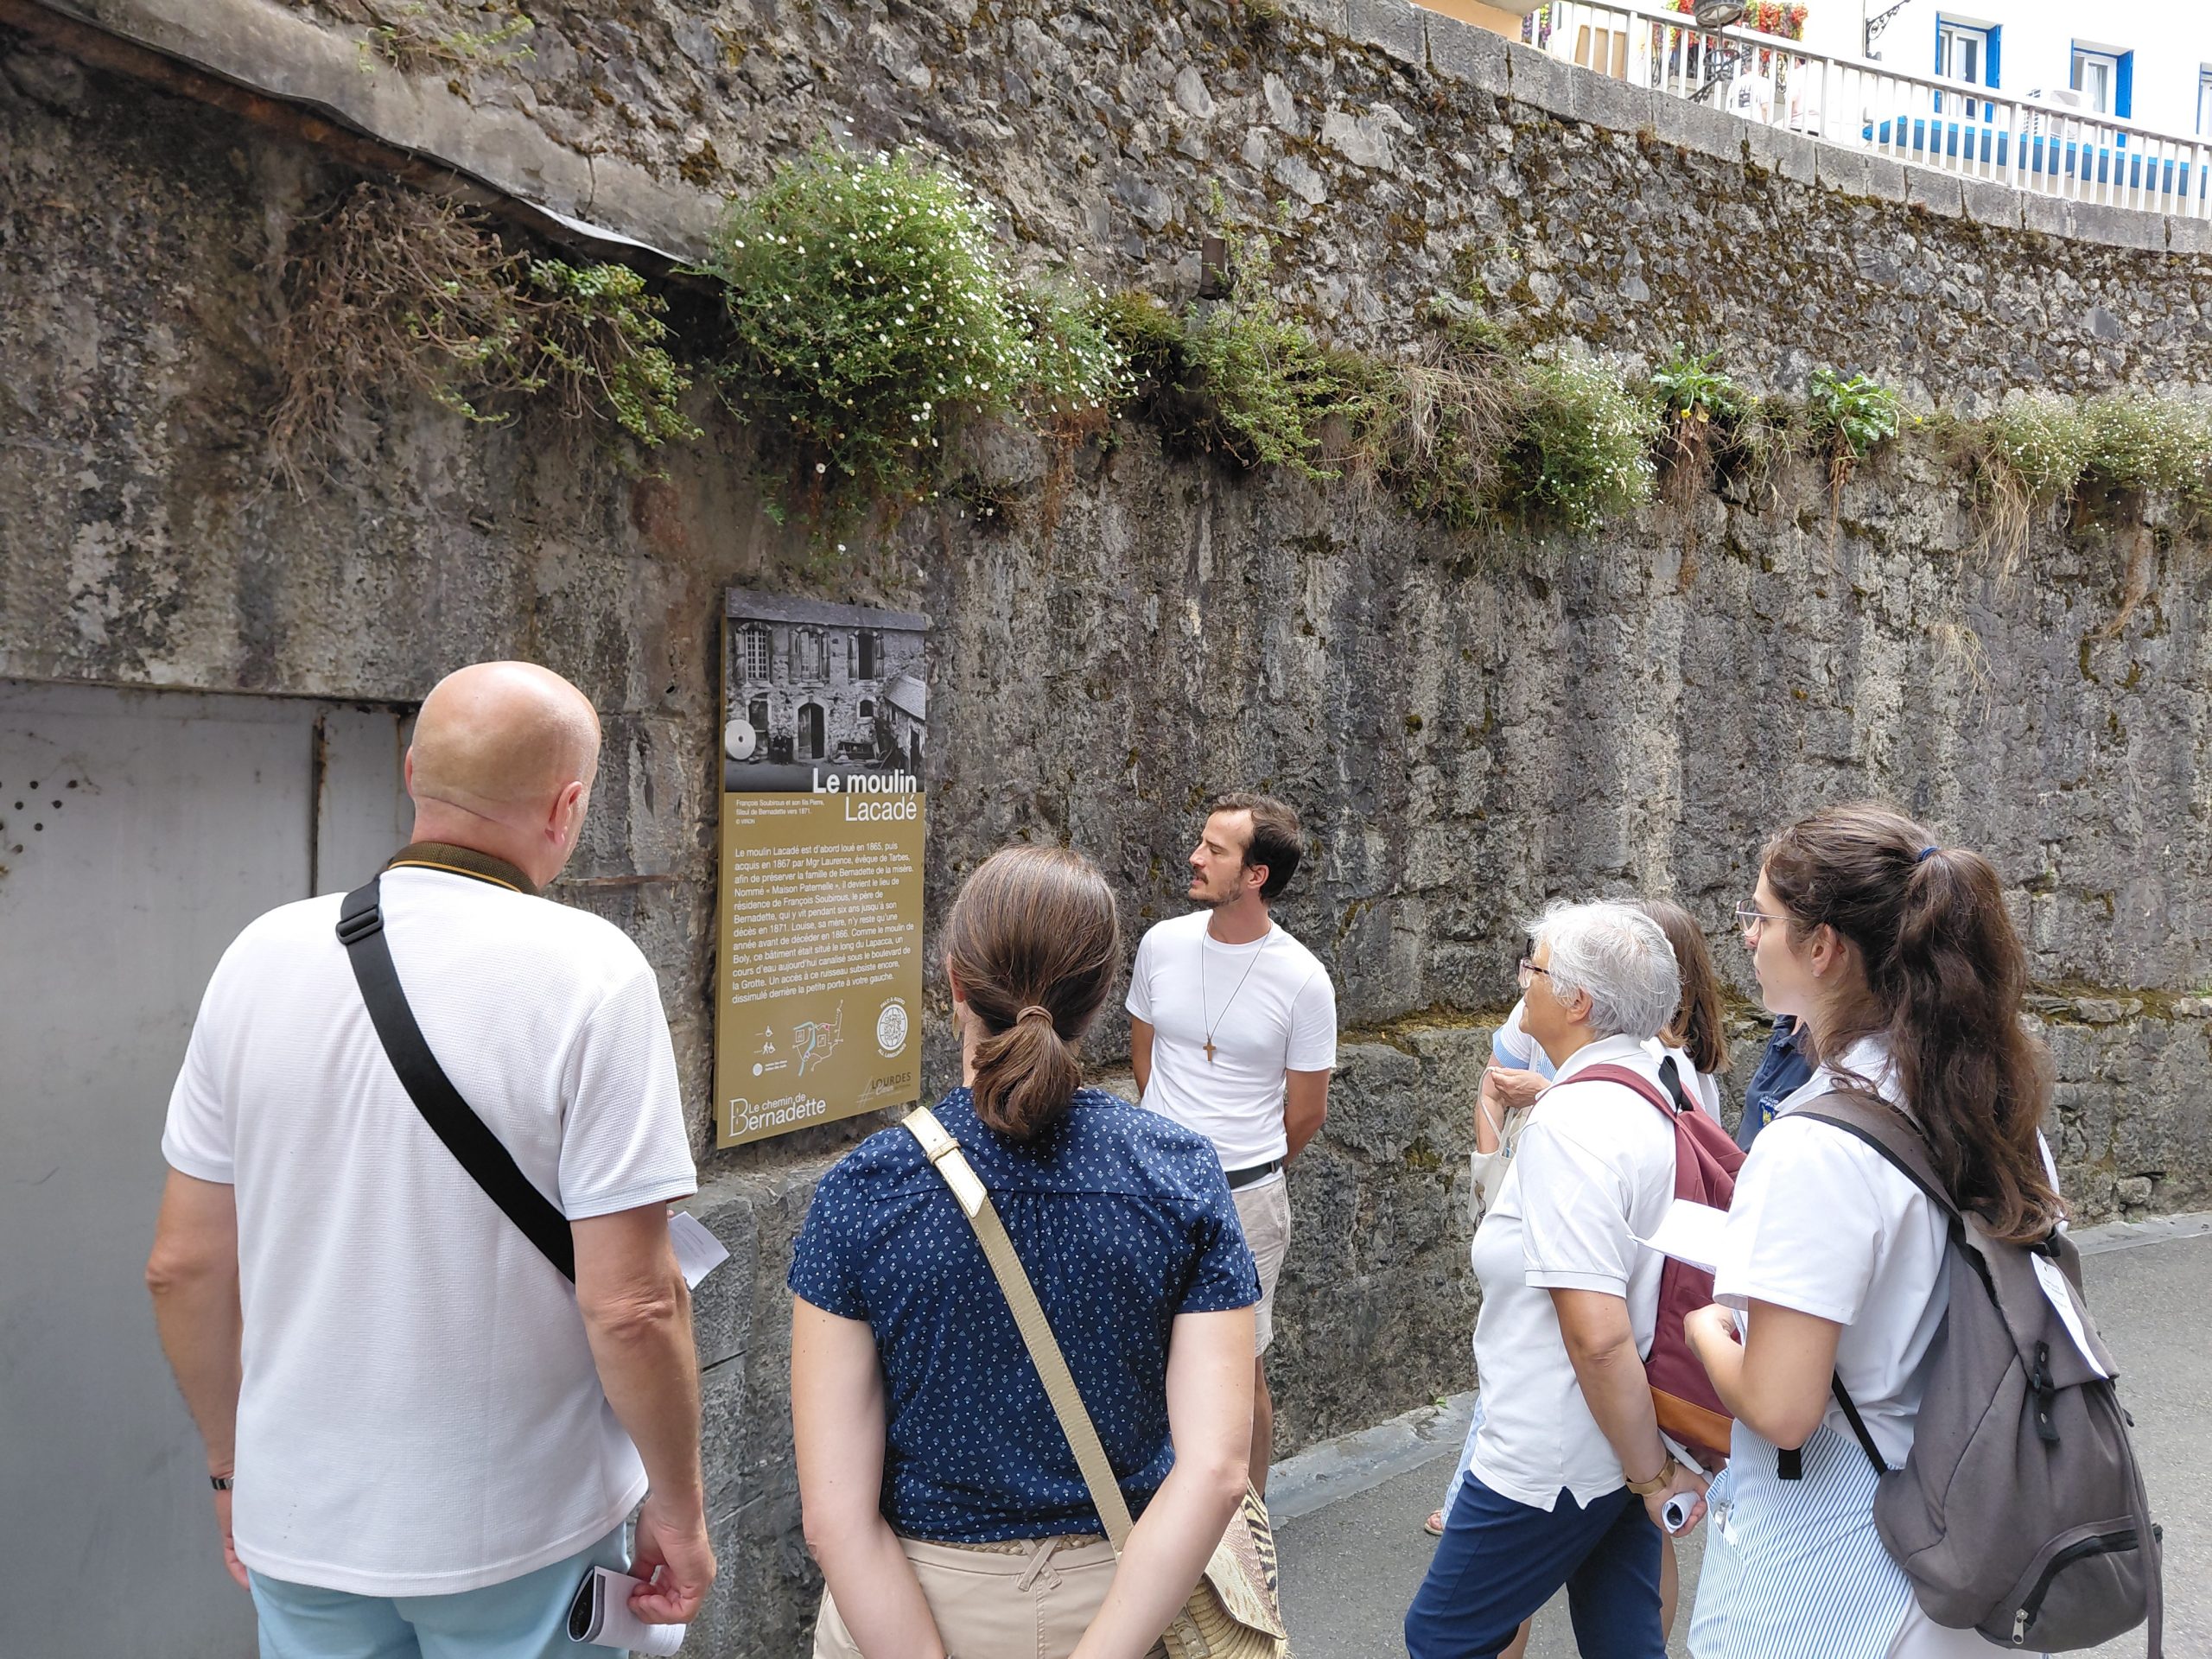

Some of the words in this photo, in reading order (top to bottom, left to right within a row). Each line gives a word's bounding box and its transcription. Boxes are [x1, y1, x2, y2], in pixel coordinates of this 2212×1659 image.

[813, 767, 840, 793] Le
[848, 768, 917, 793] moulin
[845, 794, 917, 821] Lacadé
[735, 848, 745, 857] Le
[747, 846, 772, 856] moulin
[773, 844, 799, 855] Lacadé
[801, 845, 812, 854] est
[841, 842, 855, 852] loué
[885, 842, 899, 851] puis
[734, 861, 760, 872] acquis
[773, 859, 791, 868] 1867
[792, 860, 804, 868] par
[805, 857, 819, 868] Mgr
[734, 874, 748, 884] afin
[751, 874, 760, 883] de
[762, 872, 797, 883] préserver
[798, 871, 804, 880] la
[805, 870, 828, 879] famille
[839, 868, 874, 877] Bernadette
[734, 886, 765, 897] Nommé
[772, 885, 798, 894] Maison
[799, 881, 834, 892] Paternelle
[848, 879, 871, 888] devient
[872, 878, 878, 887] le
[879, 877, 891, 886] lieu
[734, 899, 771, 911] résidence
[772, 899, 782, 907] de
[783, 896, 813, 906] François
[852, 892, 858, 900] le
[859, 891, 874, 901] père
[779, 910, 791, 920] qui
[791, 911, 797, 919] y
[798, 908, 806, 917] vit
[808, 906, 836, 918] pendant
[837, 905, 847, 914] six
[733, 939, 756, 950] année
[758, 938, 779, 948] avant
[791, 933, 820, 944] décéder
[851, 928, 876, 937] Comme
[885, 924, 905, 932] moulin
[734, 926, 757, 937] décès
[791, 920, 817, 931] Louise,
[859, 915, 875, 924] reste
[733, 954, 752, 963] Boly,
[765, 949, 796, 959] bâtiment
[798, 946, 813, 955] était
[814, 944, 830, 953] situé
[840, 942, 854, 950] long
[733, 968, 754, 977] cours
[818, 954, 846, 965] canalisé
[872, 948, 901, 958] boulevard
[733, 982, 739, 990] la
[769, 976, 779, 985] Un
[781, 973, 802, 982] accès
[804, 971, 809, 980] à
[820, 968, 848, 977] ruisseau
[849, 963, 876, 974] subsiste
[732, 989, 767, 1003] dissimulé
[769, 986, 797, 998] derrière
[798, 985, 804, 994] la
[806, 982, 825, 994] petite
[827, 980, 844, 991] porte
[846, 977, 850, 986] à
[851, 976, 868, 985] votre
[872, 1071, 912, 1090] LOURDES
[749, 1104, 760, 1114] Le
[761, 1096, 793, 1110] chemin
[795, 1092, 806, 1103] de
[728, 1097, 826, 1137] Bernadette
